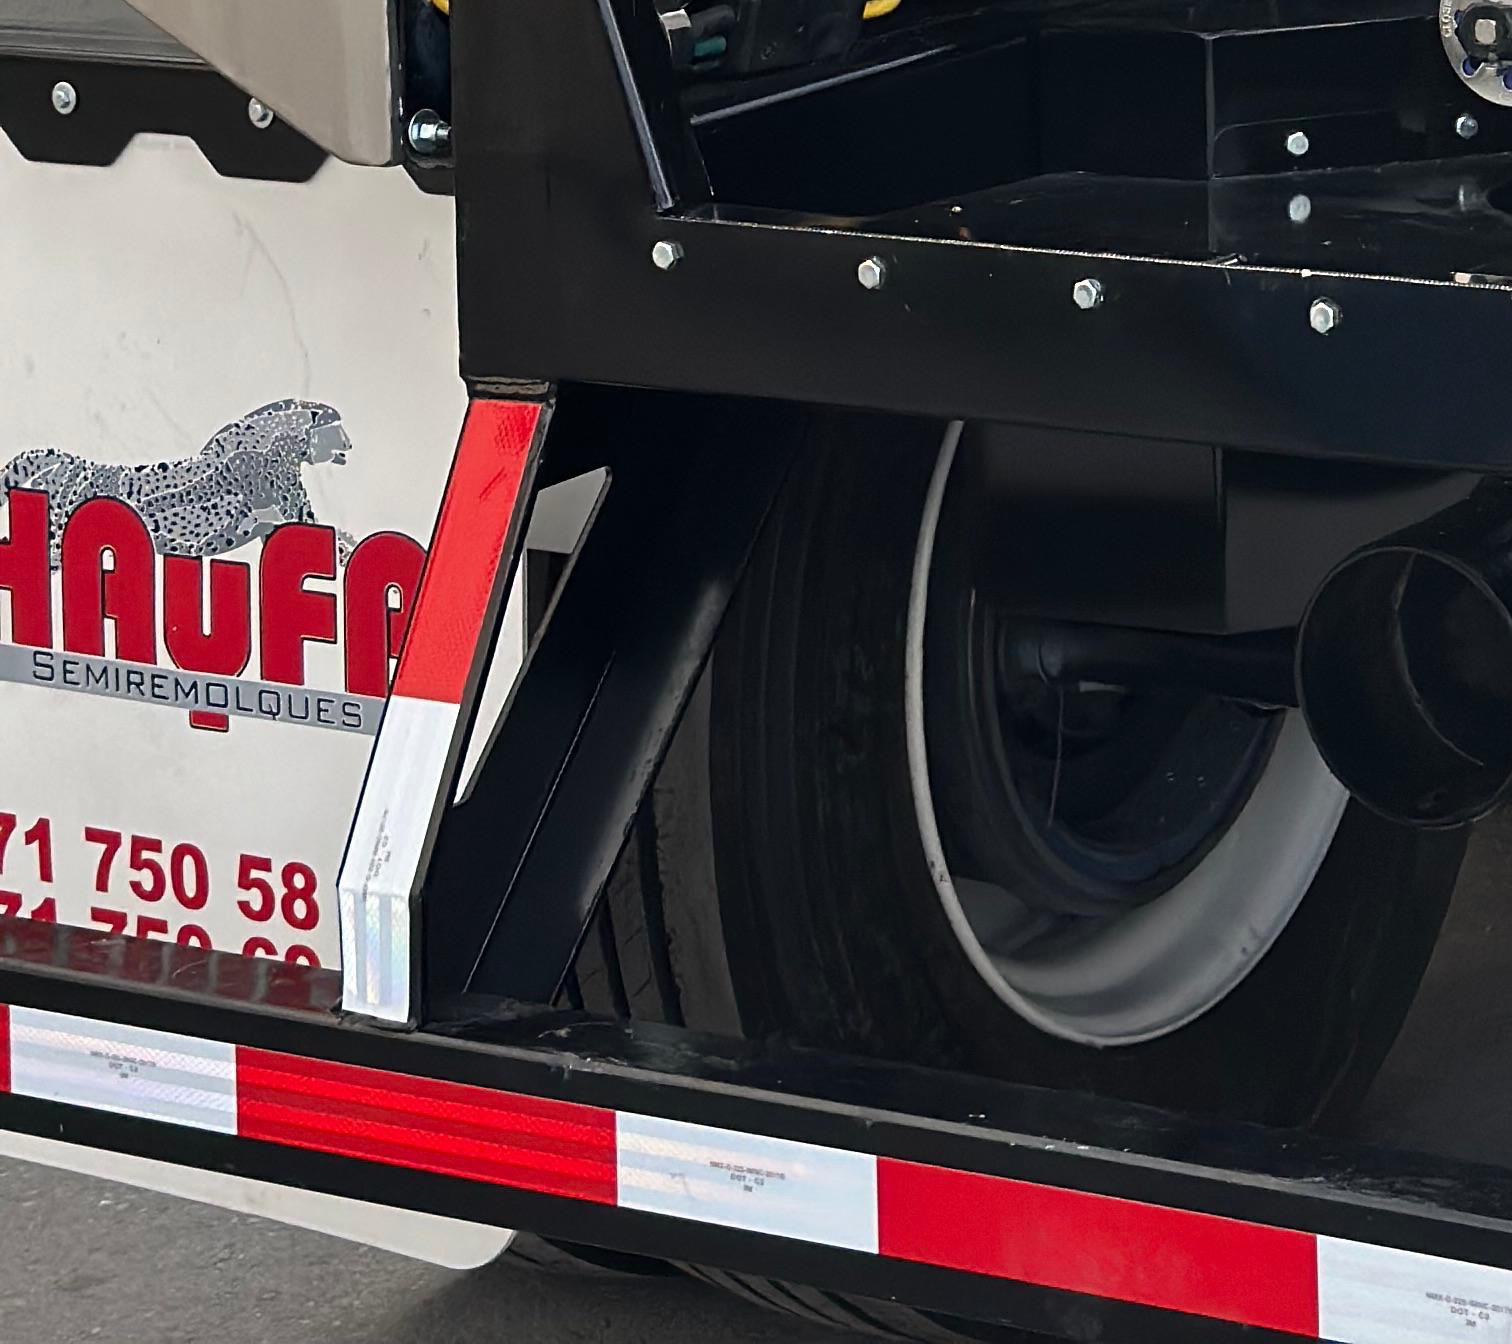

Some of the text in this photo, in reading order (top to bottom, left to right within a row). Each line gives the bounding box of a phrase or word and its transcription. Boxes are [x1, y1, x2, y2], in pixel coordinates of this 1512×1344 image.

[32, 650, 362, 729] SEMIREMOLQUES
[84, 826, 209, 910] 750
[236, 853, 320, 931] 58
